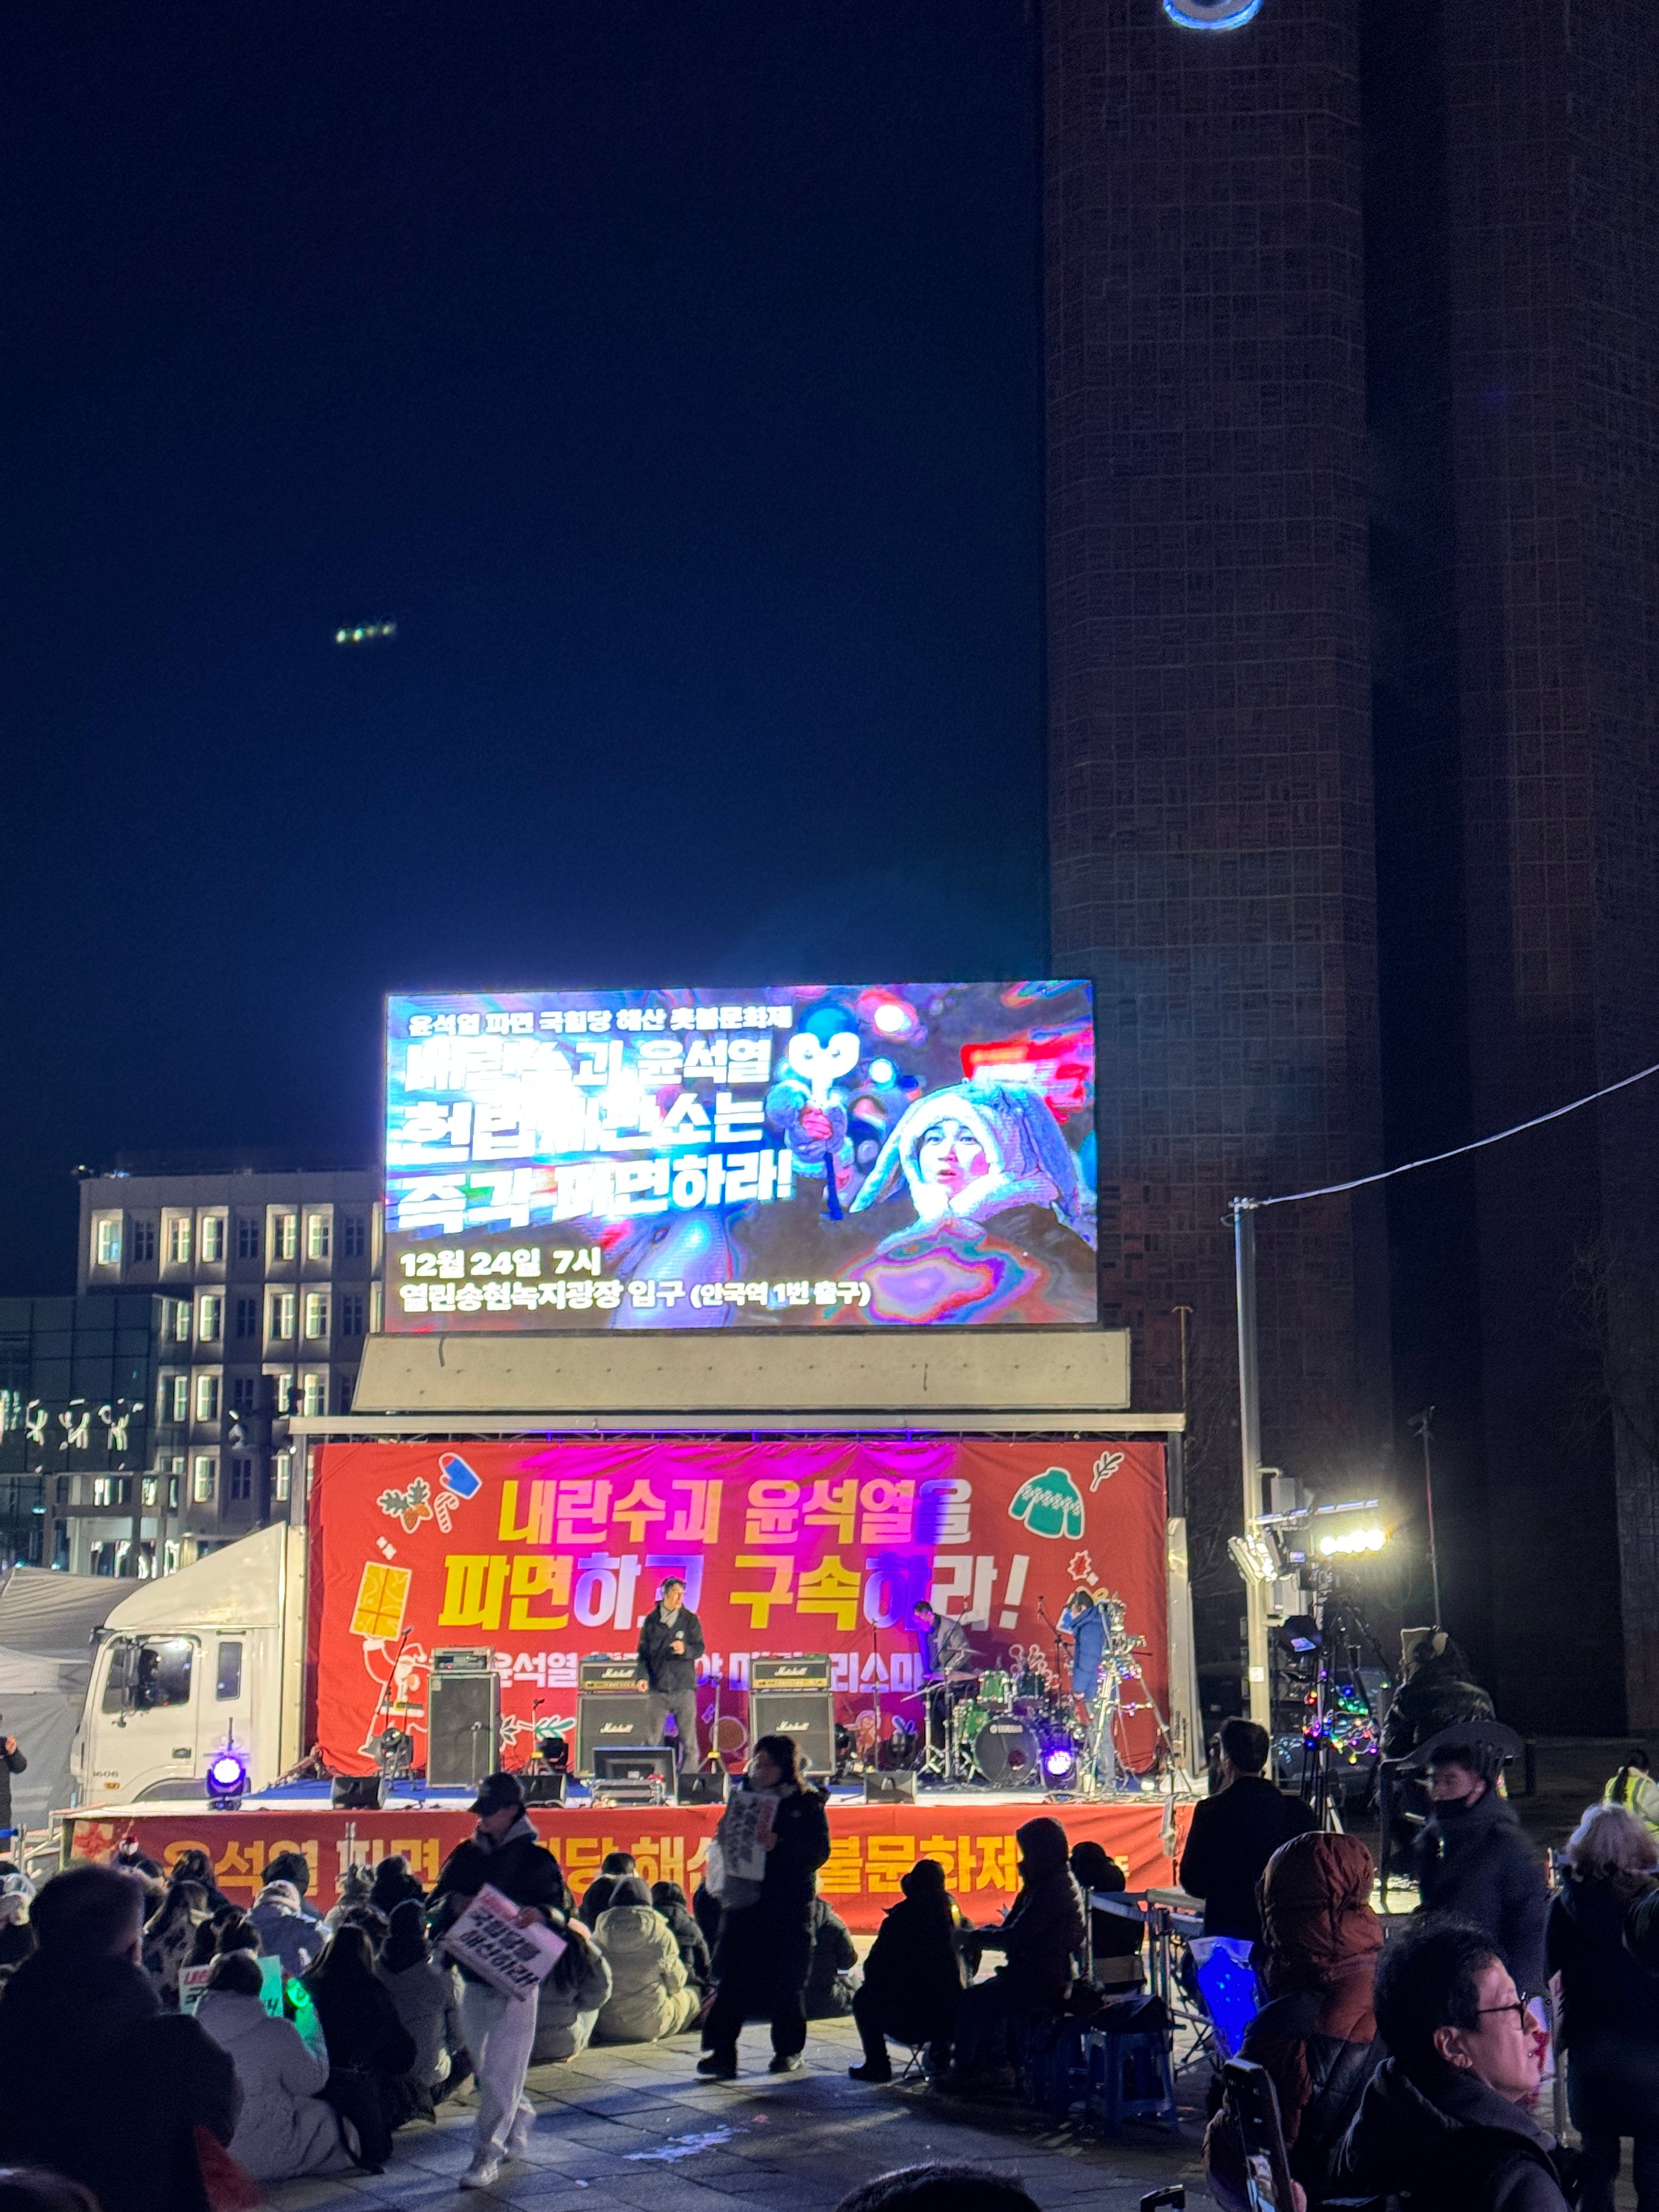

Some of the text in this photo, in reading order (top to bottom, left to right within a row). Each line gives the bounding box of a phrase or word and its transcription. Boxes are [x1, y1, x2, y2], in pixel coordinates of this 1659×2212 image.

[409, 1013, 480, 1036] 윤석열
[485, 1012, 534, 1035] 파면
[616, 1008, 667, 1031] 해산
[637, 1039, 772, 1085] 윤석열
[397, 1167, 532, 1234] 즉각
[399, 1246, 602, 1279] 12월 24일 7시
[399, 1279, 872, 1313] 열린송현녹지광장 입구 (안국역 1번 출구)
[497, 1479, 972, 1544] 내란수괴 윤석열을
[729, 1552, 1030, 1631] 구속하라!
[494, 1651, 579, 1688] 윤석열
